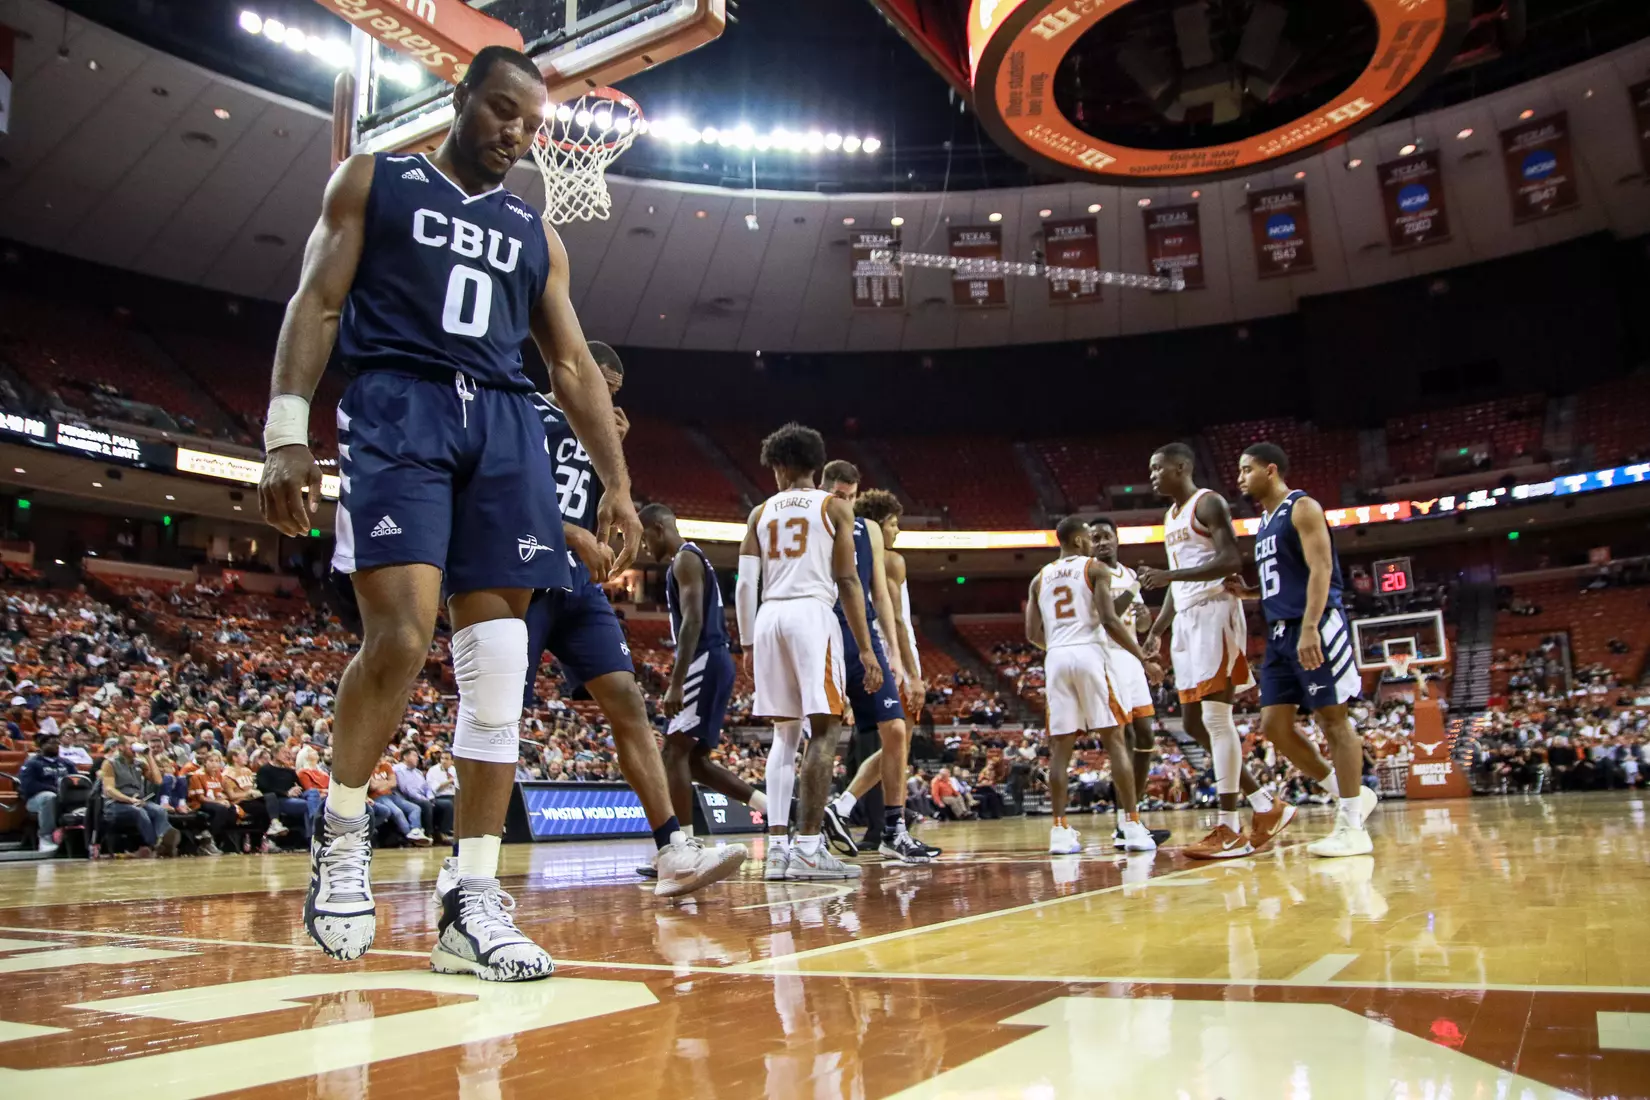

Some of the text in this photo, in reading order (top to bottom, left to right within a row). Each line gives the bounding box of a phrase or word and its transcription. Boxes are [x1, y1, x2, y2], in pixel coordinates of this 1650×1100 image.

[401, 173, 429, 183] adidas
[413, 208, 522, 273] CBU
[859, 234, 891, 244] TEXAS
[960, 231, 992, 241] TEXAS
[442, 264, 493, 338] 0
[556, 438, 592, 465] CB
[555, 464, 592, 519] 35
[774, 497, 812, 512] FEBRES
[370, 527, 403, 538] adidas
[767, 517, 809, 559] 13
[1254, 534, 1277, 562] CBU
[1259, 558, 1281, 601] 15
[1382, 571, 1407, 592] 20
[1052, 585, 1077, 619] 2
[541, 806, 646, 820] WINSTAR WORLD RESORT
